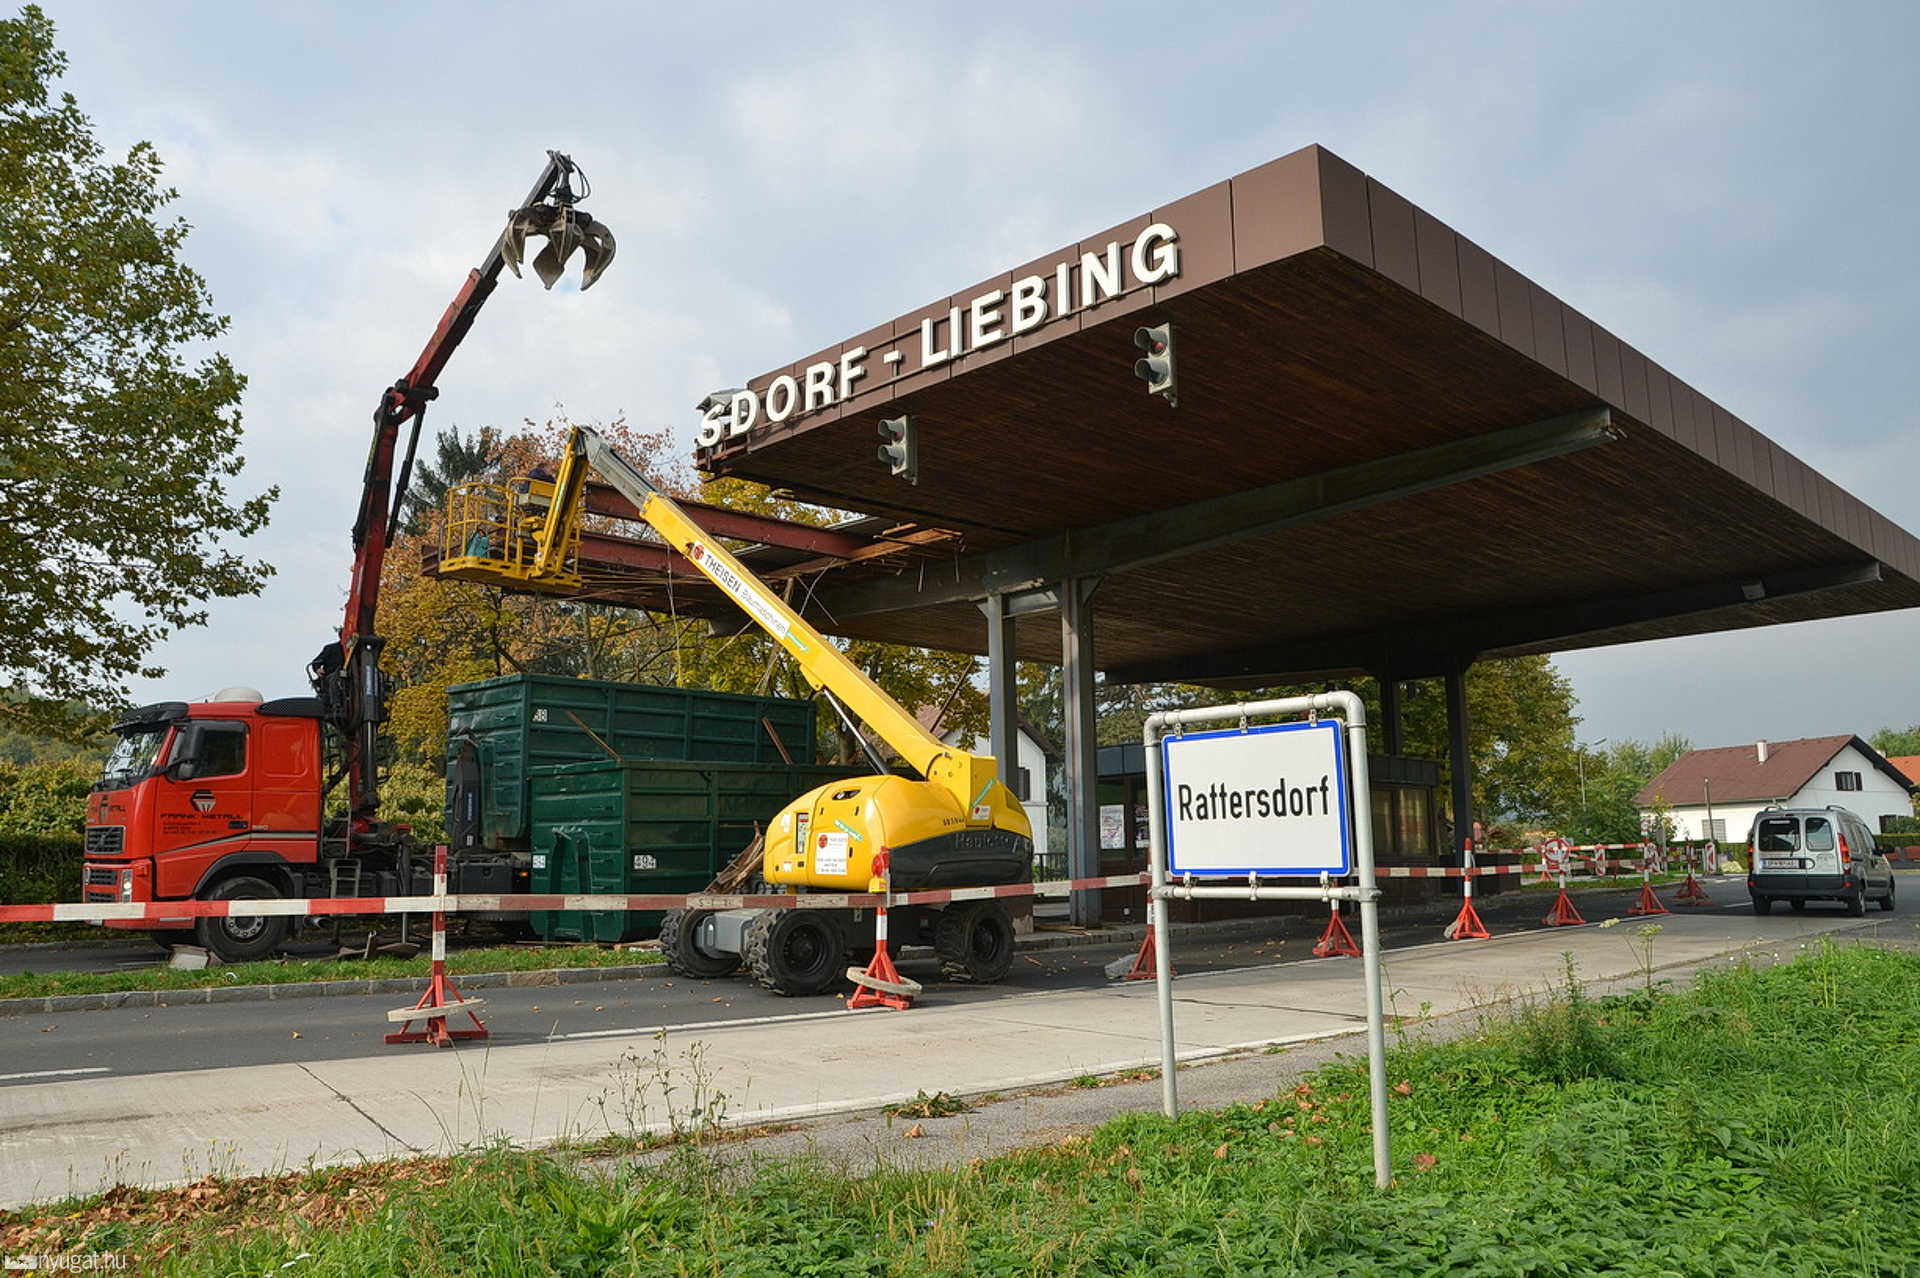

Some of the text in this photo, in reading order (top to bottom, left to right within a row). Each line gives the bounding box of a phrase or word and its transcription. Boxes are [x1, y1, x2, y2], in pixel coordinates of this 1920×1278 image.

[920, 223, 1180, 368] LIEBING
[704, 554, 742, 593] THEISEN
[1178, 775, 1329, 821] Rattersdorf
